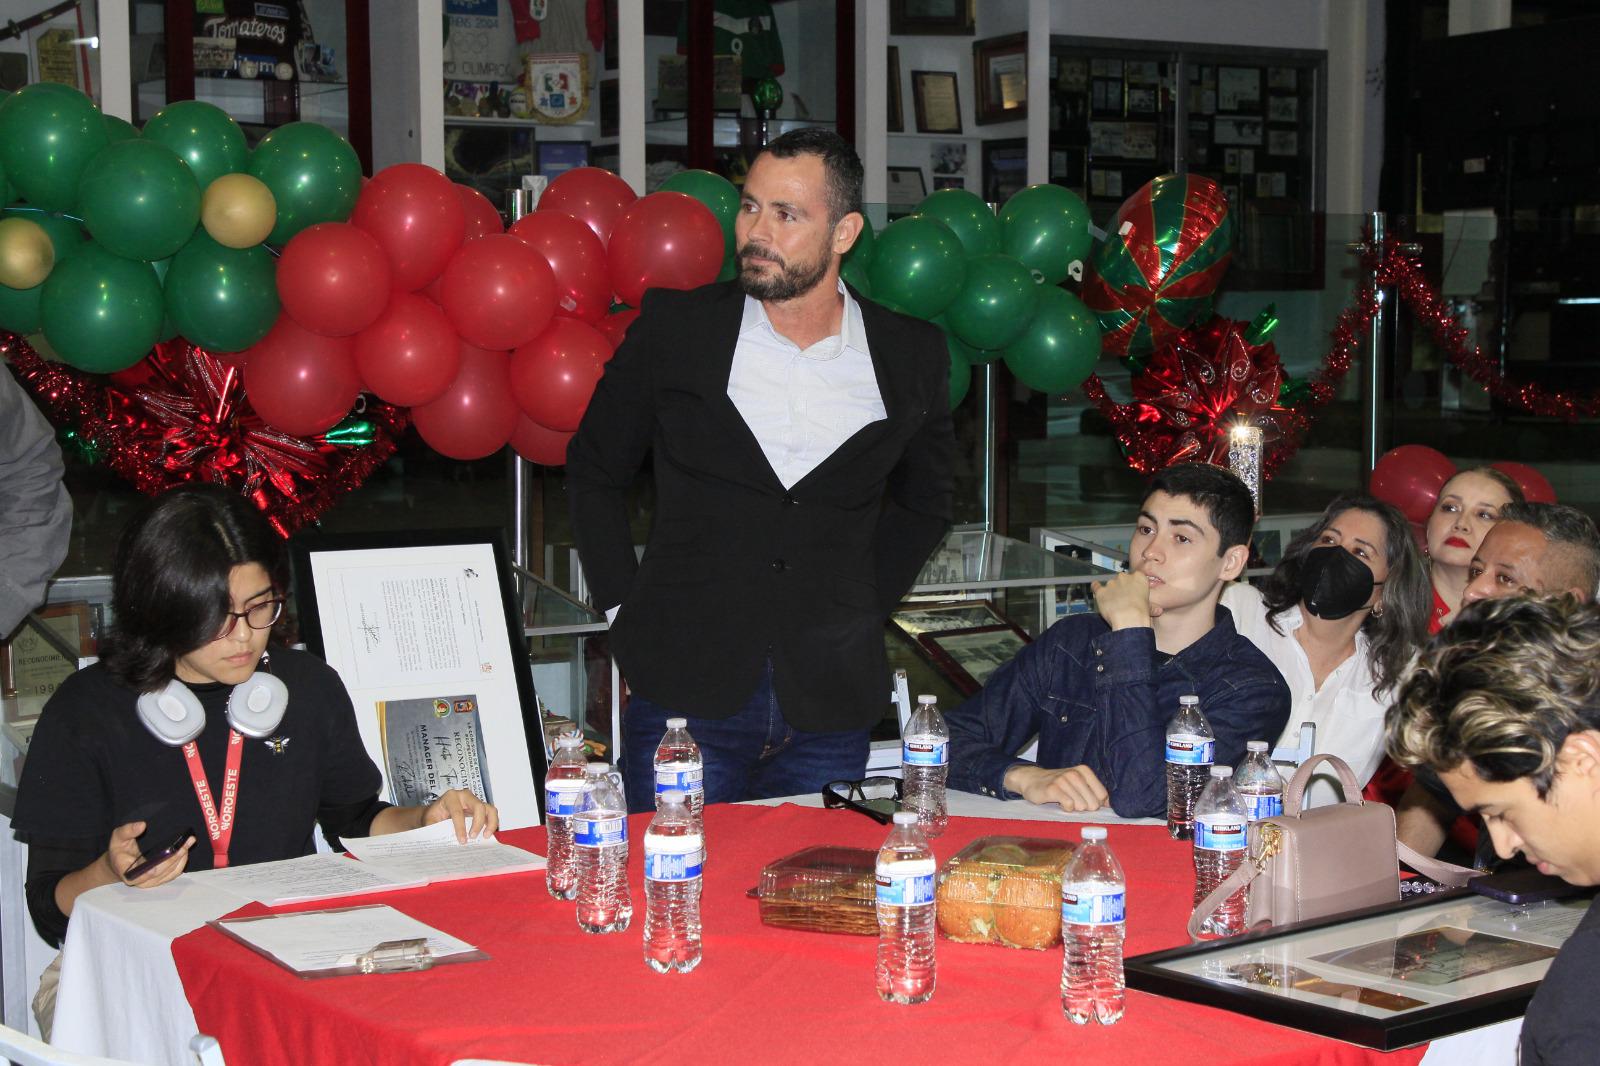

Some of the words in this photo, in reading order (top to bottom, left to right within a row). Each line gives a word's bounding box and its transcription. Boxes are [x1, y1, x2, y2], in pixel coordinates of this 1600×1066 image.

[204, 17, 286, 44] Tomateros
[420, 724, 434, 770] MANAGER
[428, 772, 437, 790] DEL
[197, 779, 221, 841] NOROESTE
[220, 768, 238, 831] NOROESTE
[1213, 824, 1241, 832] KIRKLAND
